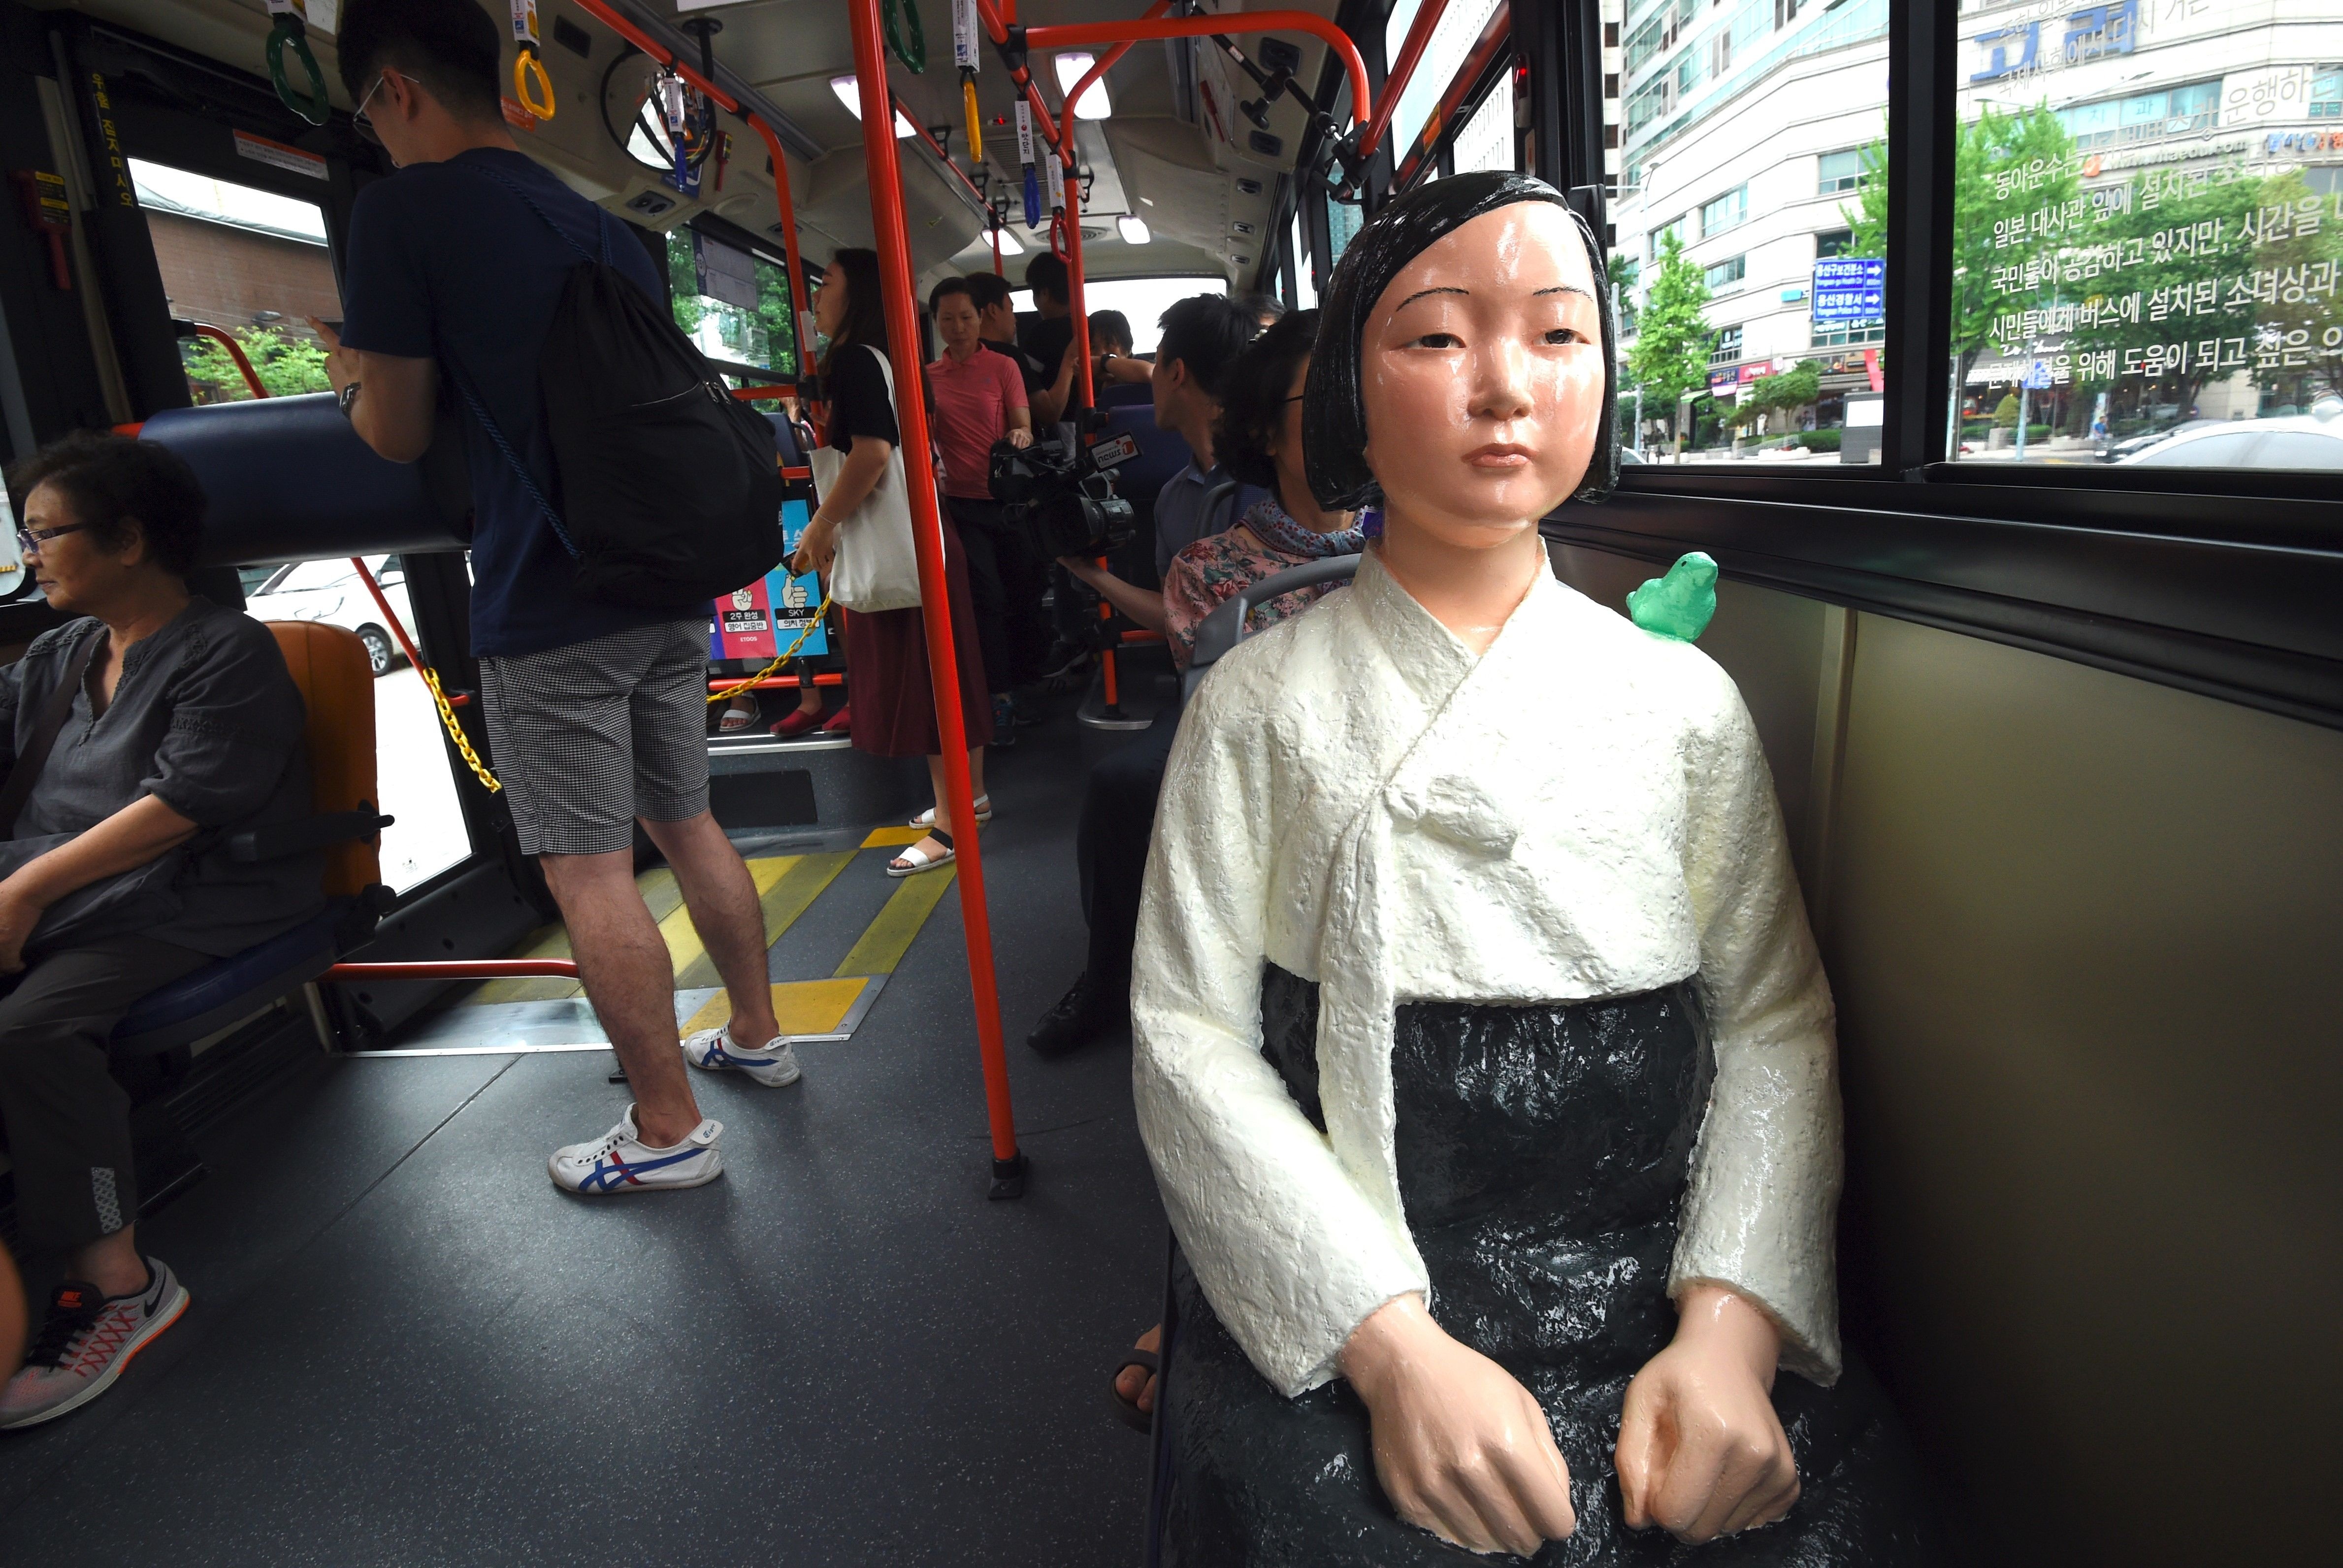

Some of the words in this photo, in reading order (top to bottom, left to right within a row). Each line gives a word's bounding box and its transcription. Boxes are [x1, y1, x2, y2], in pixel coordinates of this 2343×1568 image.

[1998, 24, 2106, 98] 국제사회에서
[1994, 148, 2083, 201] 동아운수는
[2225, 60, 2342, 126] 운행하는
[1993, 213, 2026, 249] 일본
[2031, 196, 2086, 236] 대사관
[2092, 182, 2133, 223] 앞에
[2139, 165, 2209, 211] 설치된
[1991, 255, 2058, 295] 국민들이
[2064, 237, 2145, 282] 공감하고
[2152, 217, 2228, 265] 있지만,
[2236, 195, 2325, 246] 시간을
[1818, 293, 1862, 307] 용산경찰서
[1989, 302, 2074, 342] 시민들에게
[2080, 291, 2141, 329] 버스에
[2147, 278, 2217, 322] 설치된
[2224, 258, 2342, 306] 소녀상과
[2077, 349, 2116, 381] 위해
[2121, 341, 2188, 378] 도움이
[2195, 337, 2246, 372] 되고
[2255, 329, 2311, 368] 싶은
[1097, 449, 1121, 463] news
[730, 612, 742, 621] 2주
[744, 611, 758, 620] 완성
[743, 621, 763, 630] 집중반
[788, 609, 805, 617] SKY
[703, 1123, 716, 1139] Tiger
